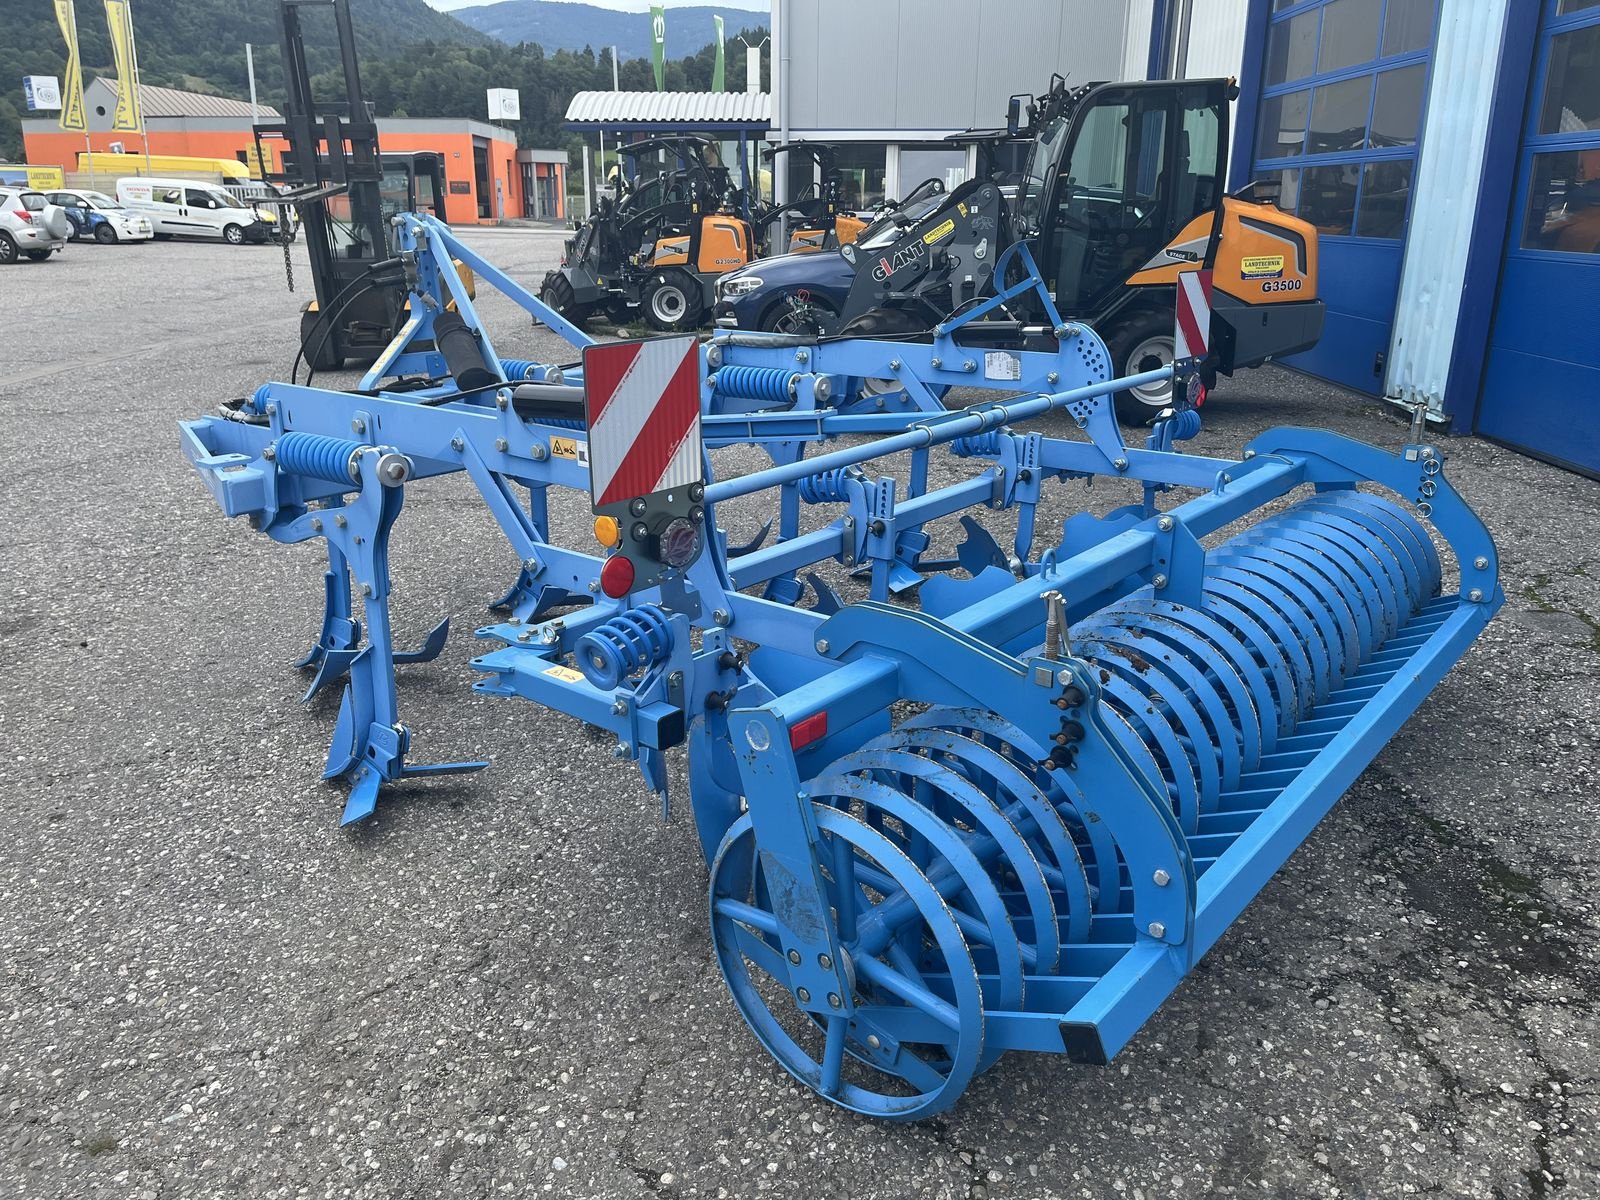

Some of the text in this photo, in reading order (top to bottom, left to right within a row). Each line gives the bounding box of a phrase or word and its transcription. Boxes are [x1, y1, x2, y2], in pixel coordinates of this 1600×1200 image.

[872, 239, 925, 281] GIANT
[1169, 251, 1186, 259] STAGE
[1244, 260, 1281, 268] LANDTECHNIK
[1261, 280, 1302, 293] G3500
